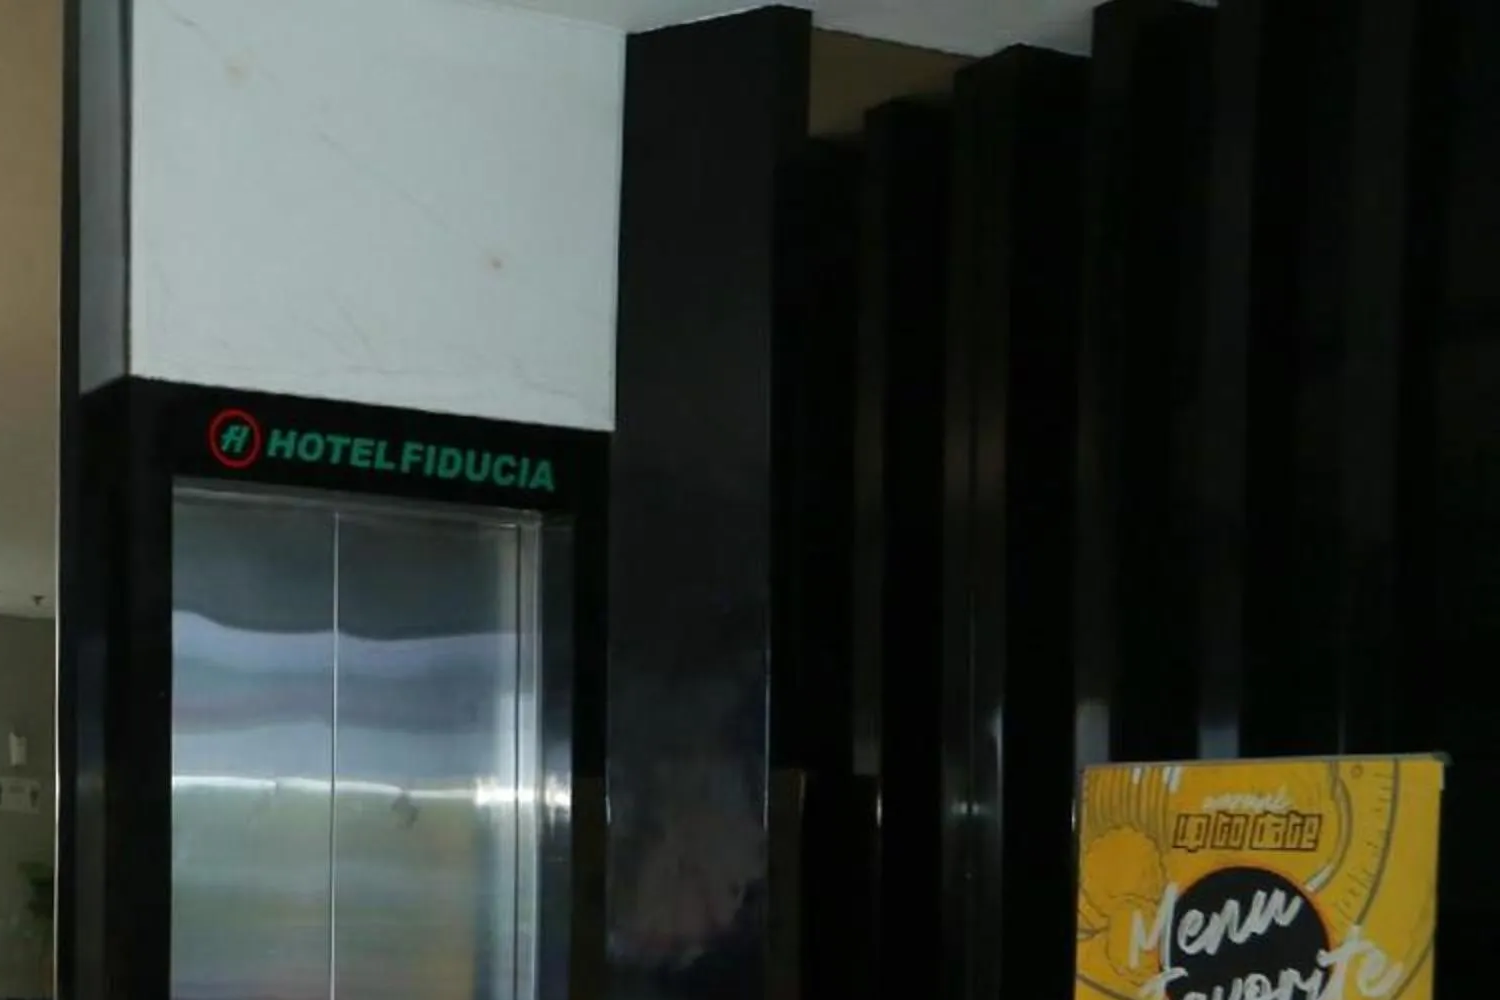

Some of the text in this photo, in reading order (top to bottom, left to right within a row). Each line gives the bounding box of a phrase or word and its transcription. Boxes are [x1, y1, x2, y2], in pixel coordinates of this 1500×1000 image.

[268, 429, 396, 472] HOTEL
[401, 442, 555, 492] FIDUCIA
[1128, 882, 1302, 969] Menu
